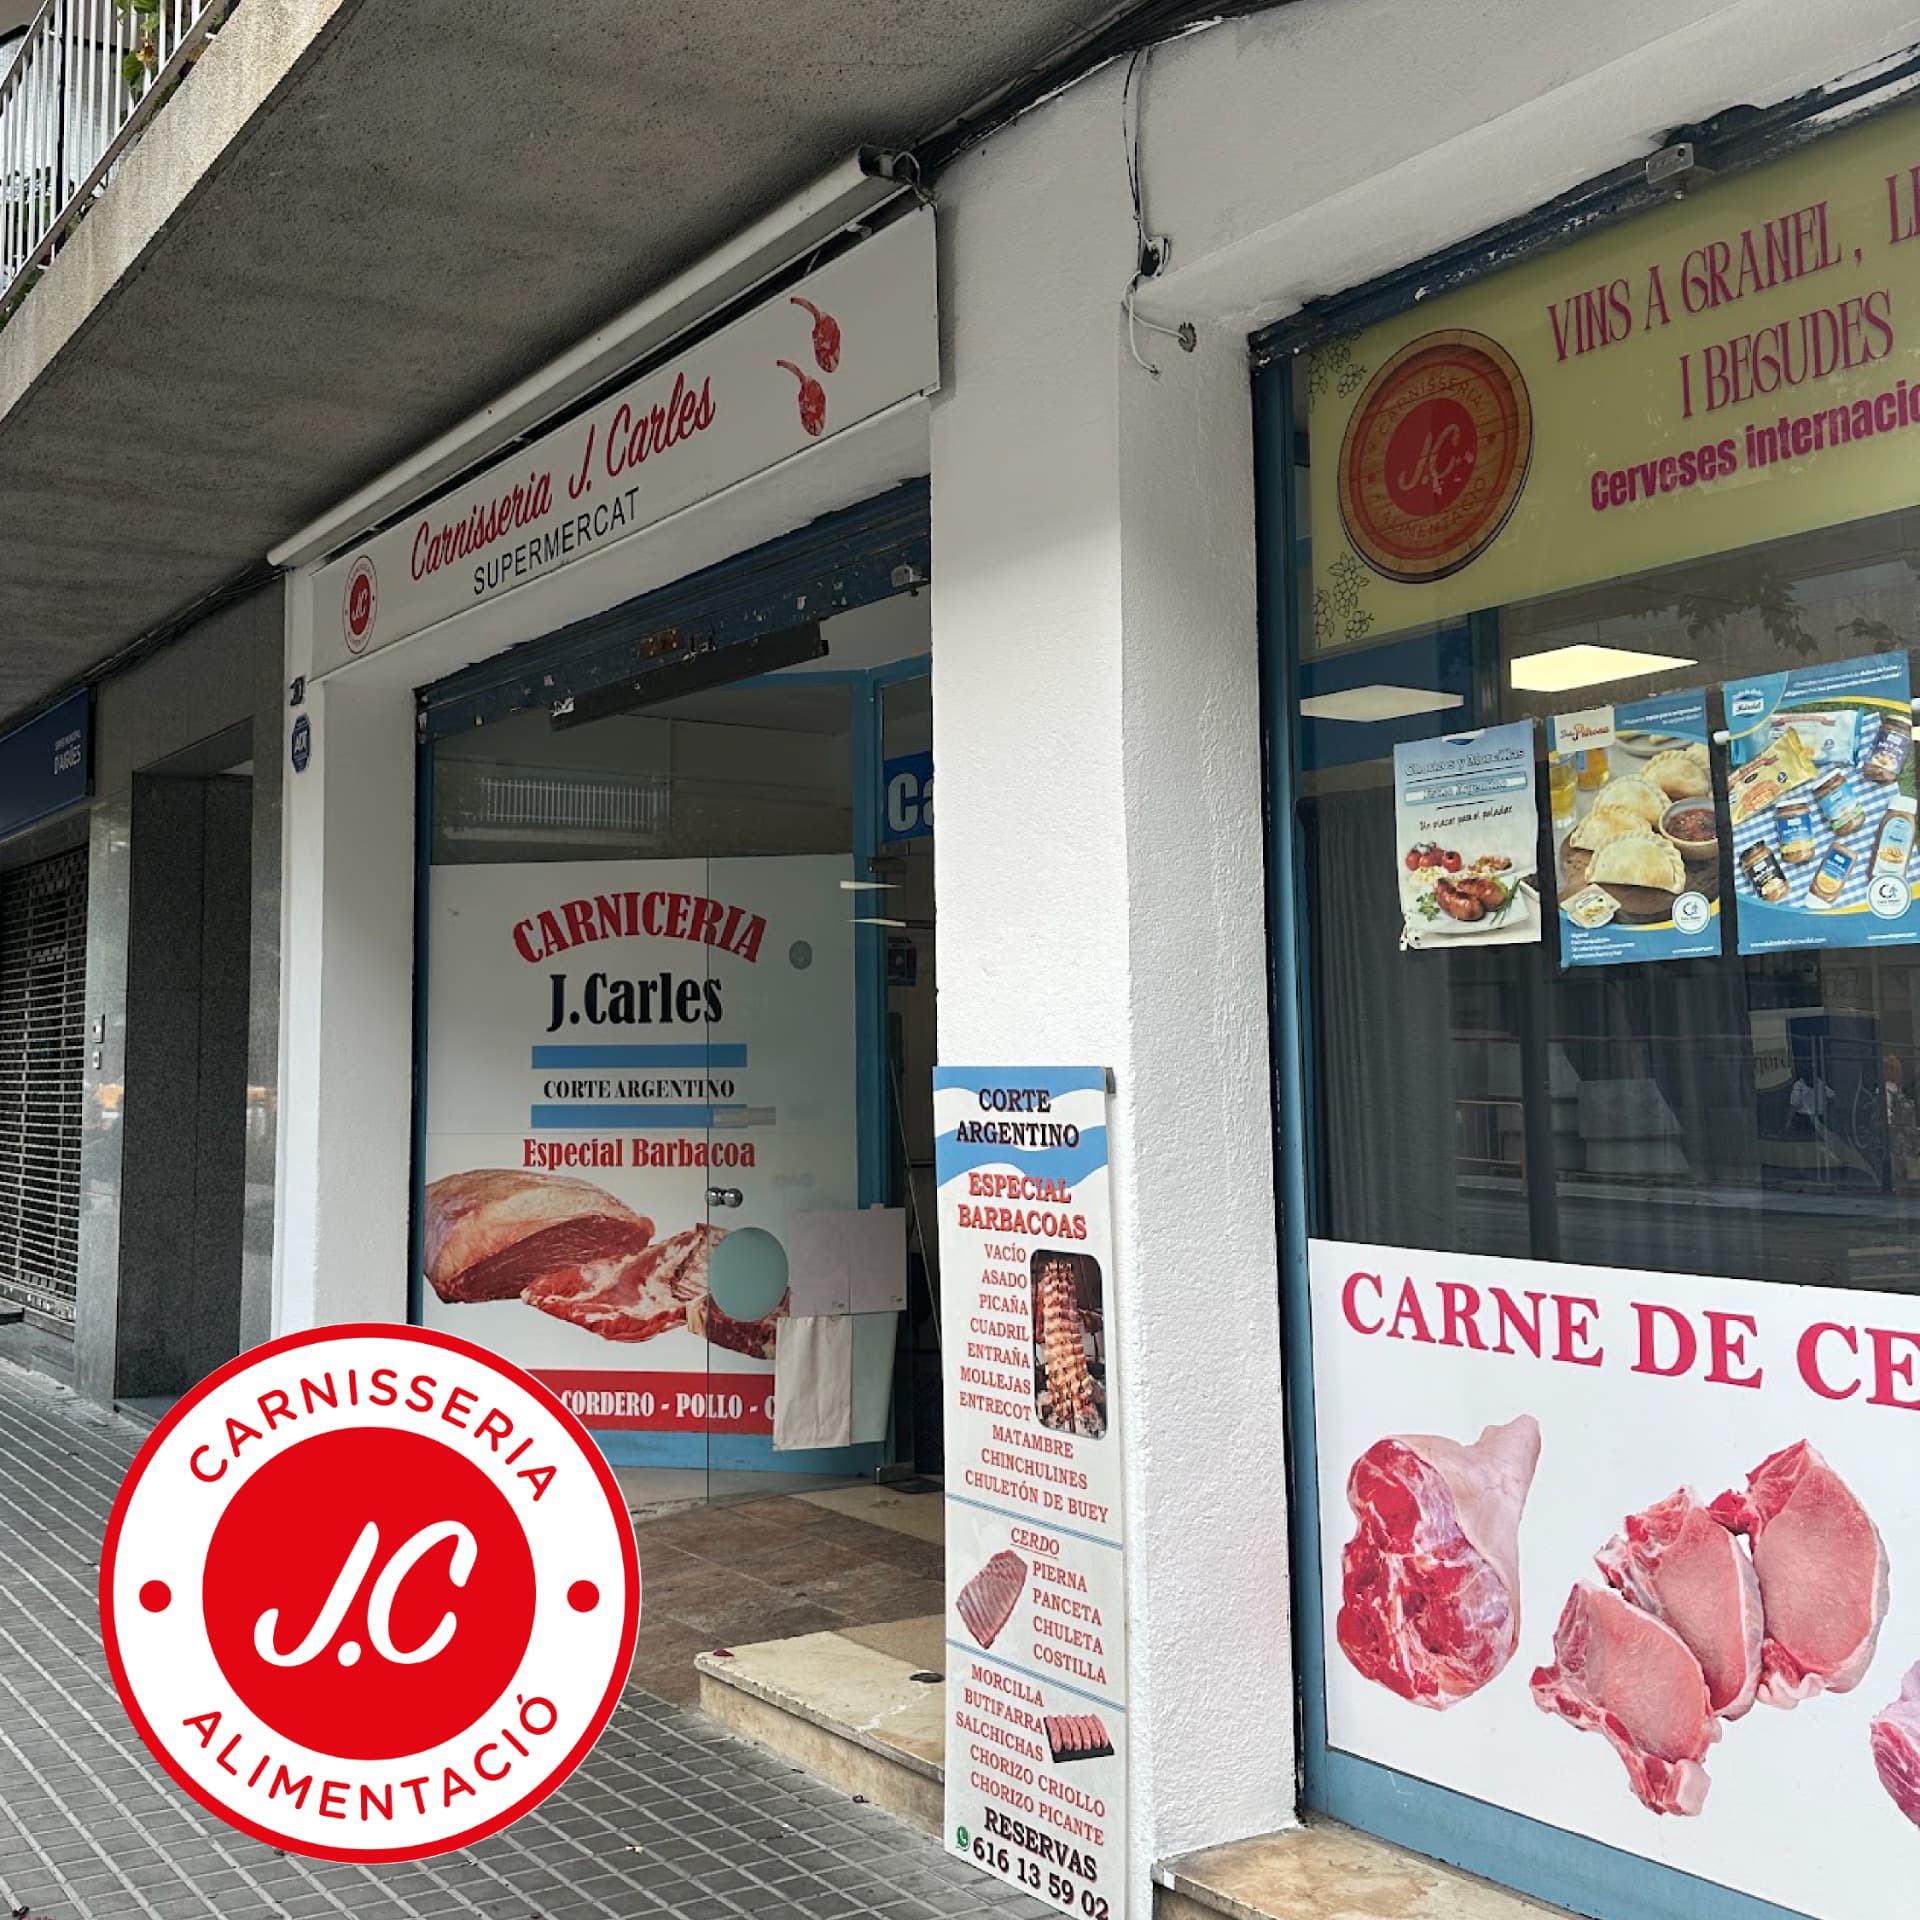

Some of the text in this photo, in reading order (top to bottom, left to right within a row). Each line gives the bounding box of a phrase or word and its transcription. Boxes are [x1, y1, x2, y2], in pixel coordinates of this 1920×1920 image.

[1547, 278, 1632, 362] VINS
[1644, 265, 1670, 331] A
[1680, 290, 1894, 418] I BEGUDES
[411, 371, 716, 581] Carnisseria J. Carles
[1591, 438, 1737, 512] Cerveses
[472, 488, 640, 595] SUPERMERCAT
[512, 890, 768, 964] CARNICERIA
[545, 972, 724, 1032] J.Carles
[543, 1078, 736, 1099] CORTE ARGENTINO
[979, 1088, 1052, 1113] CORTE
[522, 1137, 756, 1170] Especial Barbacoa
[956, 1120, 1080, 1148] ARGENTINO
[968, 1172, 1072, 1204] ESPECIAL
[957, 1204, 1088, 1240] BARBACOAS
[984, 1243, 1026, 1263] VACÍO
[982, 1268, 1028, 1289] ASADO
[978, 1293, 1029, 1316] PICAÑA
[970, 1317, 1030, 1342] CUADRIL
[1341, 1271, 1920, 1411] CARNE DE CE
[967, 1342, 1031, 1369] ENTRAÑA
[960, 1365, 1031, 1396] MOLLEJAS
[561, 1390, 655, 1417] CORDERO
[676, 1392, 744, 1420] POLLO
[959, 1391, 1033, 1421] ENTRECOT
[992, 1424, 1074, 1460] MATAMBRE
[981, 1447, 1088, 1490] CHINCHULINES
[965, 1469, 1109, 1524] CHULETÓN DE BUEY
[1010, 1527, 1060, 1556] CERDO
[1032, 1560, 1088, 1593] PIERNA
[1033, 1587, 1103, 1627] PANCETA
[1033, 1615, 1104, 1655] CHULETA
[1033, 1643, 1107, 1685] COSTILLA
[971, 1663, 1045, 1708] MORCILLA
[964, 1687, 1044, 1736] BUTIFARRA
[956, 1710, 1044, 1763] SALCHICHAS
[970, 1743, 1106, 1818] CHORIZO CRIOLLO
[971, 1771, 1104, 1847] CHORIZO PICANTE
[984, 1806, 1098, 1884] RESERVAS
[973, 1836, 1110, 1920] 616 13 59 02
